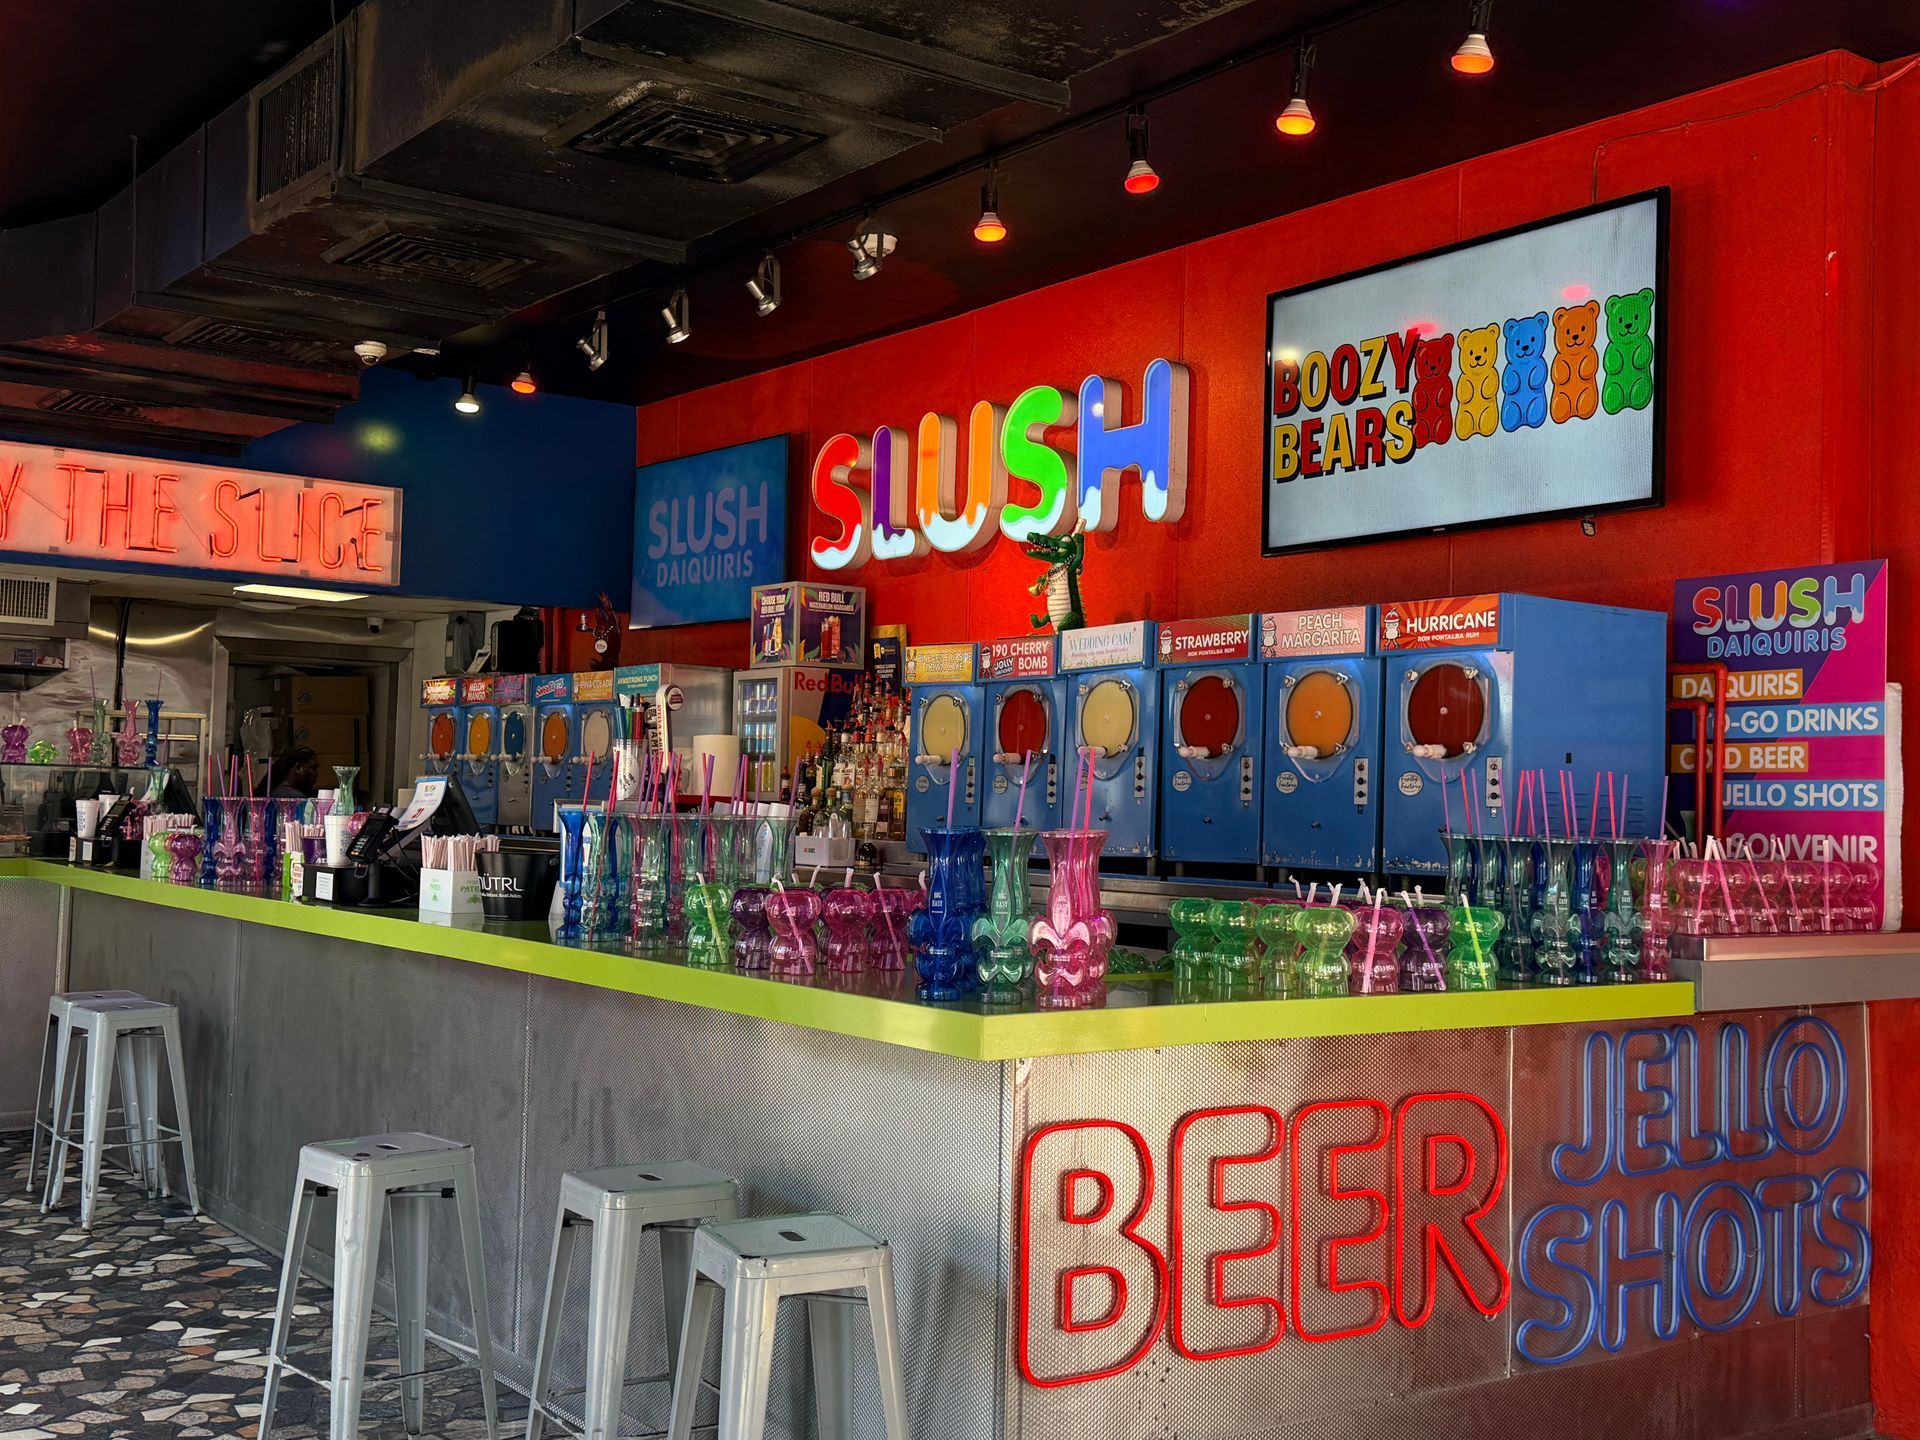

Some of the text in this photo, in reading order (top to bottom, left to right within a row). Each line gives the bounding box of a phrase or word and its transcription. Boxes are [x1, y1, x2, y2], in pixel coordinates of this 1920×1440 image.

[1273, 328, 1420, 417] BOOZY
[1273, 400, 1418, 482] BEARS
[811, 358, 1185, 570] SLUSH
[56, 463, 179, 553] THE
[209, 480, 384, 572] SLICE
[647, 481, 768, 560] SLUSH
[656, 549, 754, 588] DAIQUIRIS
[818, 591, 845, 604] RED BULL
[1692, 573, 1865, 635] SLUSH
[1298, 613, 1342, 630] PEACH
[1406, 611, 1496, 633] HURRICANE
[992, 641, 1049, 657] 190 CHERRY
[1069, 631, 1135, 651] WEDDING CAKE
[1175, 630, 1250, 650] STRAWBERRY
[1281, 628, 1362, 649] MARGARITA
[1707, 627, 1847, 659] DAIQUIRIS
[1018, 655, 1048, 670] BOMB
[794, 671, 828, 692] Red
[1681, 672, 1799, 699] DAQUIRIS
[1707, 706, 1879, 733] O-GO DRINKS
[1680, 745, 1805, 770] CD BEER
[1722, 783, 1879, 807] JELLO SHOTS
[1728, 832, 1878, 863] SOUVENIR
[1551, 1016, 1849, 1187] JELLO
[1018, 1092, 1511, 1387] BEER
[1515, 1167, 1873, 1365] SHOTS
